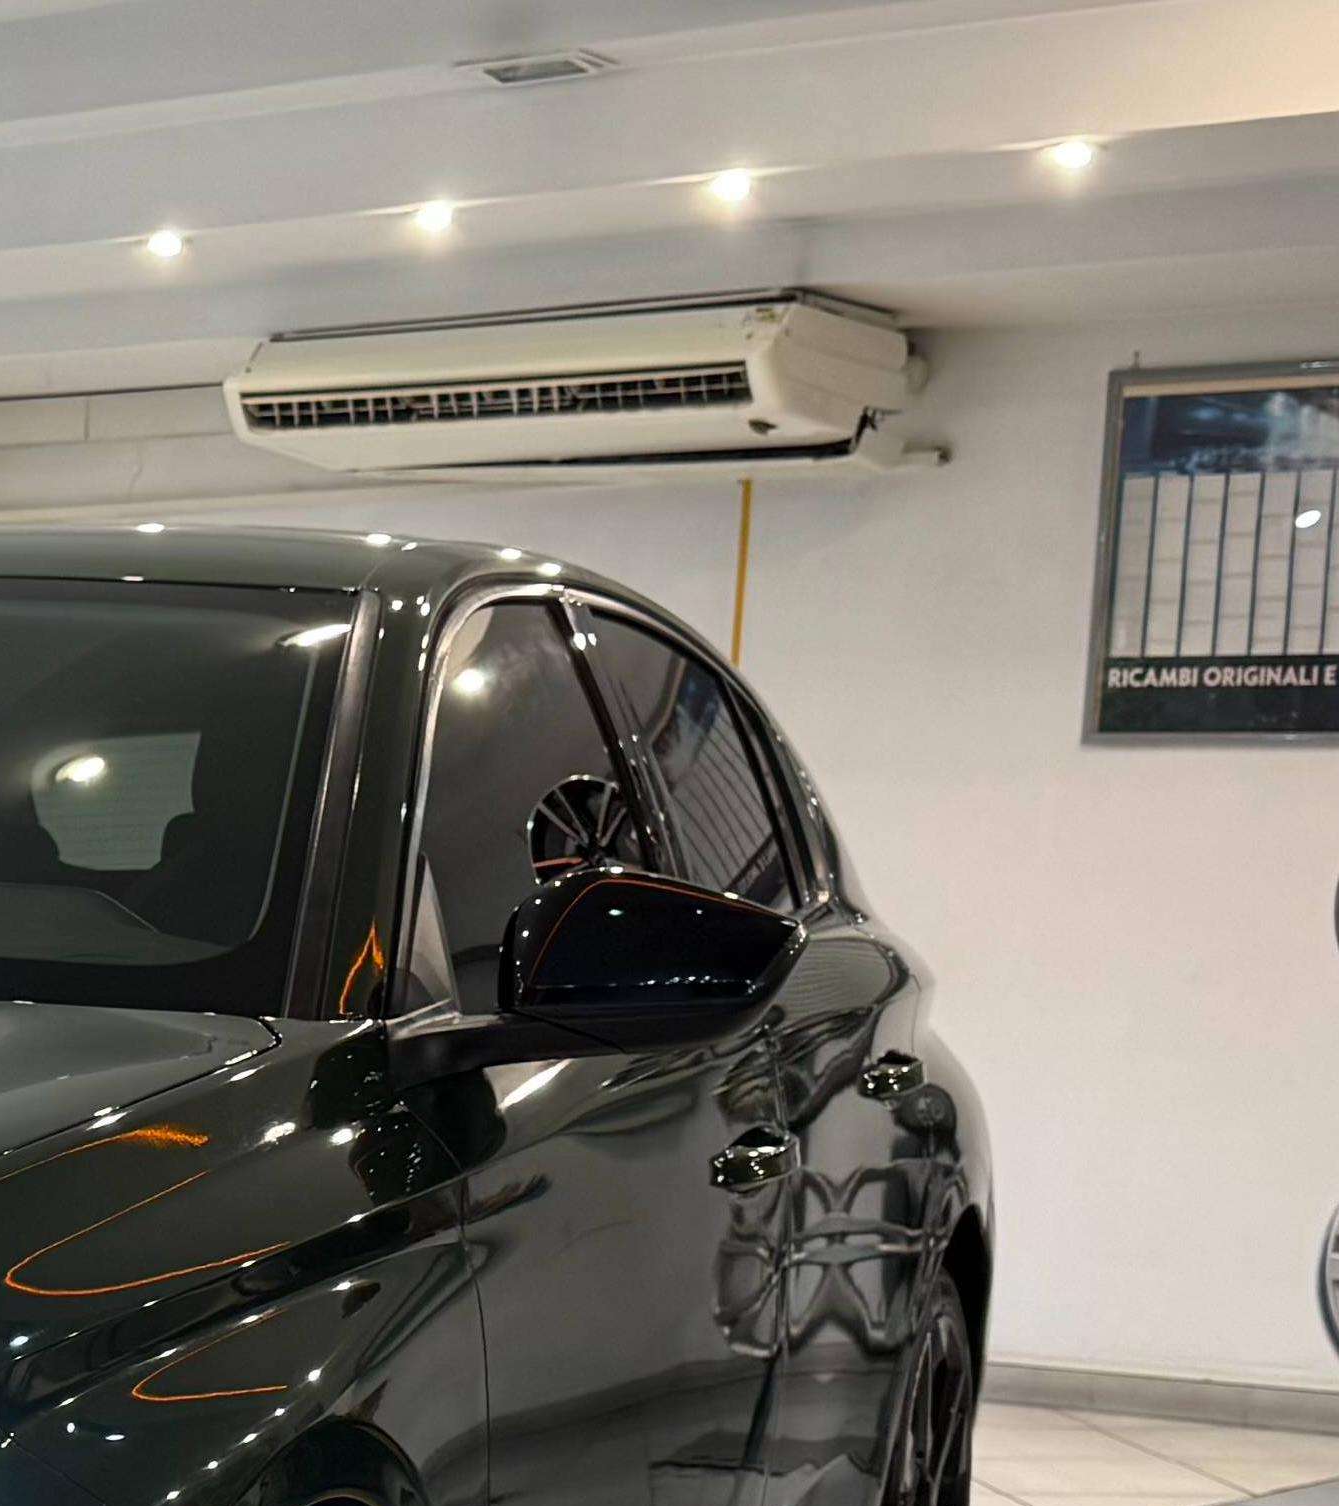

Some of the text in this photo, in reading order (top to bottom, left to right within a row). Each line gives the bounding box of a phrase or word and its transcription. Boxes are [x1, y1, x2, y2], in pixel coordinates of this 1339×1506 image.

[1107, 664, 1338, 688] RICAMBI ORIGINALI E
